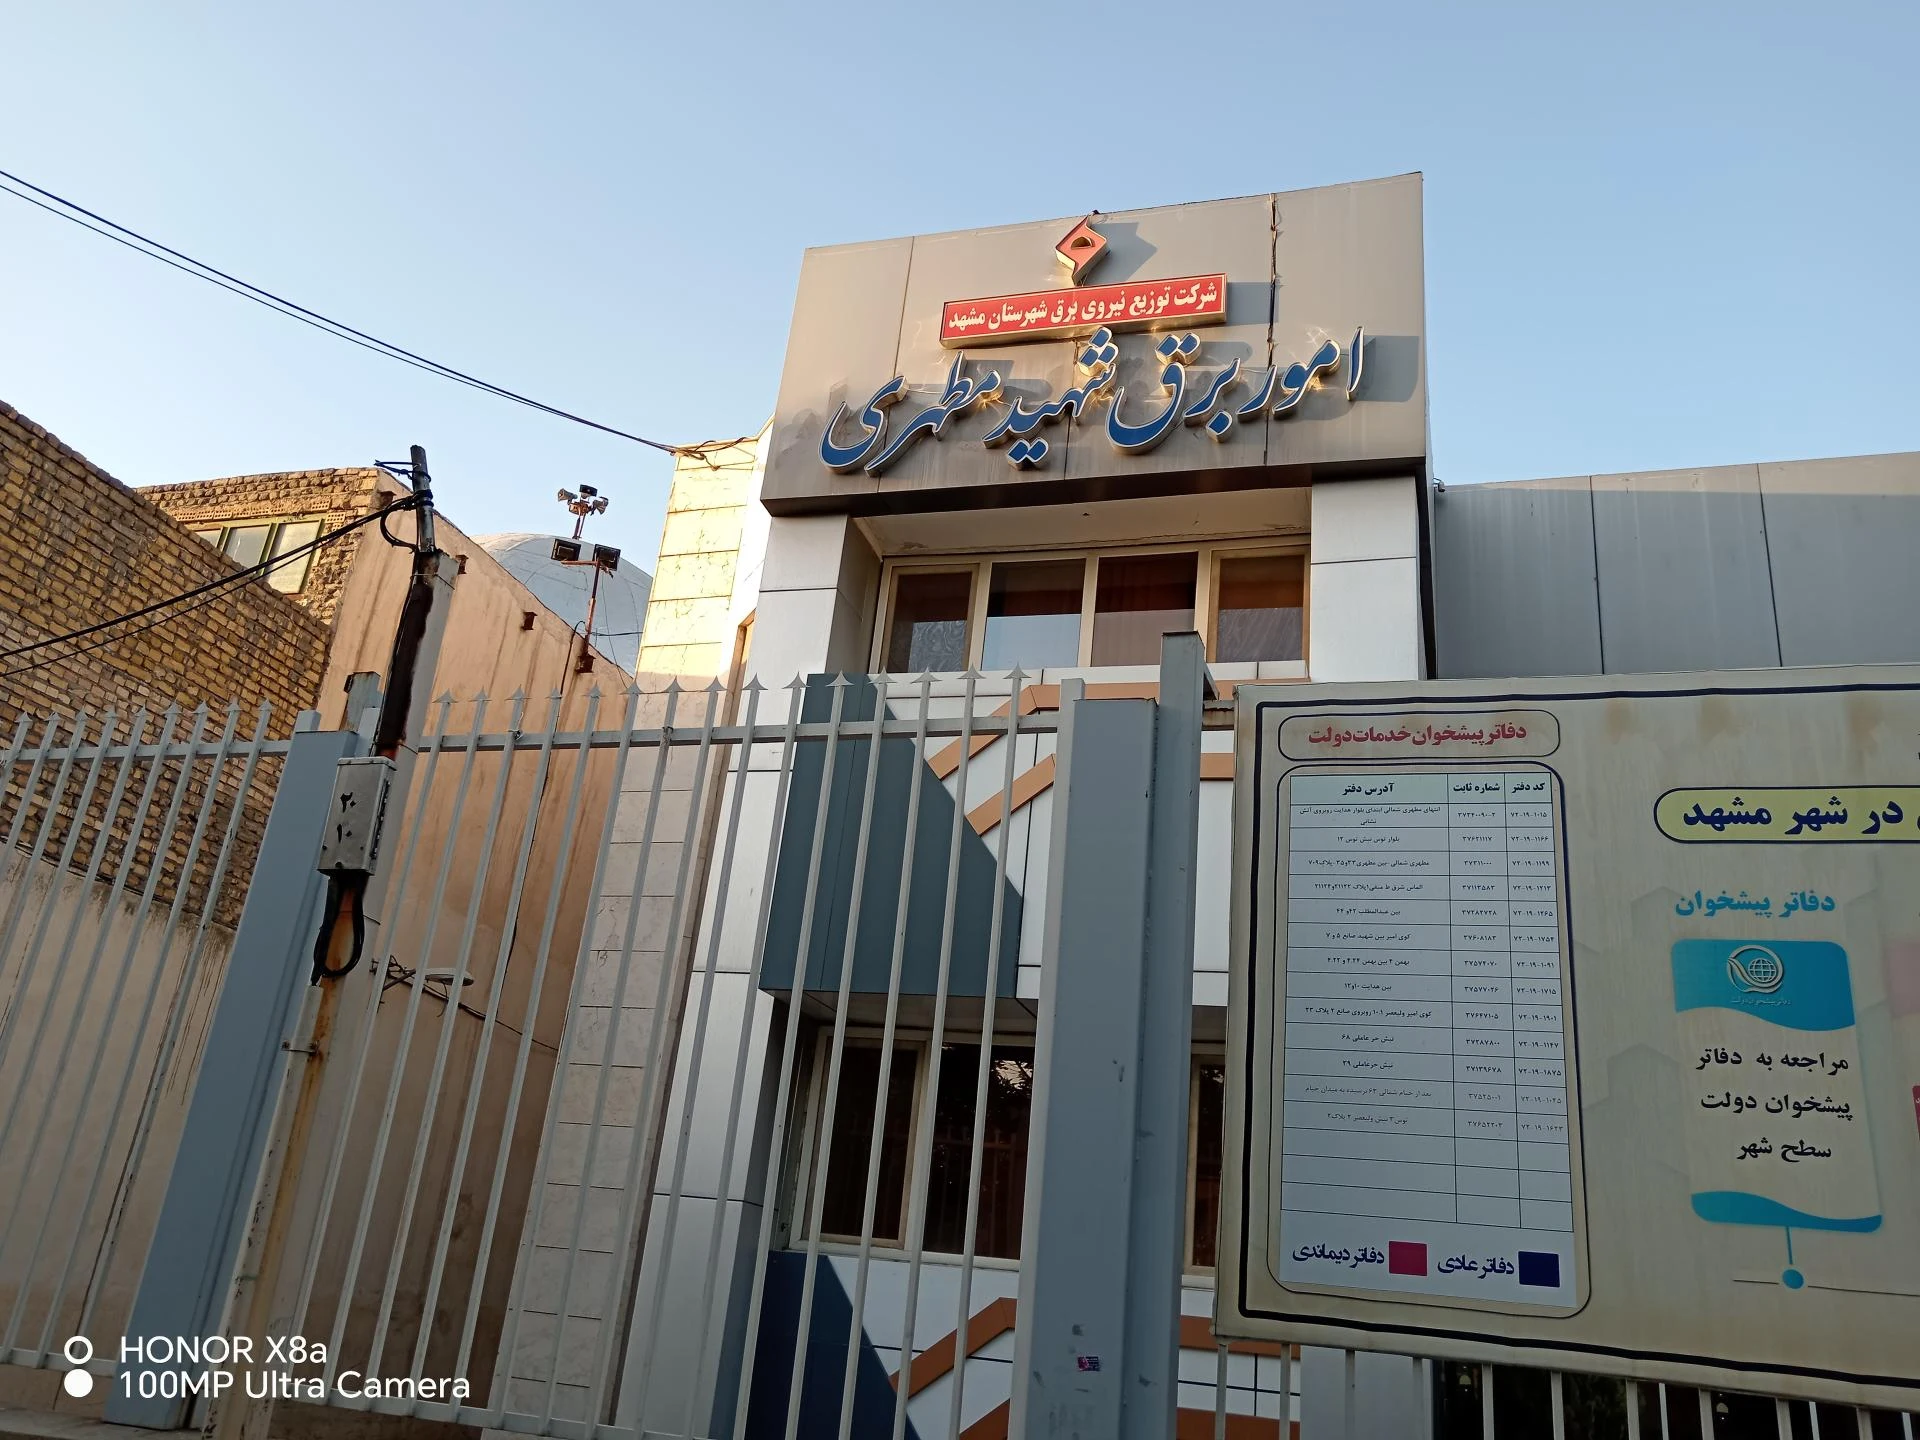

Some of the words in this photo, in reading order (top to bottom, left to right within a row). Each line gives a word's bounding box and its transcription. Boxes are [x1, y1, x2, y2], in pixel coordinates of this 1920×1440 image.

[1081, 291, 1126, 319] نیروی
[1130, 288, 1171, 315] توزیع
[1174, 282, 1217, 309] شرکت
[949, 308, 986, 331] مشهد
[988, 299, 1048, 330] شهرستان
[1050, 298, 1077, 322] برق
[1237, 326, 1365, 421] امور
[982, 326, 1120, 469] شهید
[1104, 330, 1240, 456] برق
[818, 350, 1003, 477] مطهری
[1309, 727, 1353, 747] دولت
[1353, 726, 1411, 742] خدمات
[1412, 725, 1485, 746] پیشخوان
[1485, 722, 1527, 745] دفاتر
[1342, 783, 1362, 795] دفتر
[1365, 783, 1395, 795] آدرس
[1453, 782, 1473, 794] ثابت
[1475, 782, 1500, 793] شماره
[1512, 782, 1531, 793] دفتر
[1533, 782, 1545, 791] کد
[1683, 796, 1772, 832] مشهد
[1784, 796, 1848, 835] شهر
[1861, 801, 1903, 834] در
[1675, 889, 1773, 918] پیشخوان
[1779, 889, 1835, 917] دفاتر
[1696, 1047, 1743, 1070] دفاتر
[1756, 1053, 1772, 1071] به
[1780, 1052, 1849, 1076] مراجعه
[1701, 1092, 1757, 1113] دولت
[1765, 1094, 1853, 1121] پیشخوان
[1737, 1137, 1773, 1159] شهر
[1781, 1139, 1831, 1163] سطح
[1292, 1243, 1351, 1264] دیماندی
[1349, 1246, 1385, 1268] دفاتر
[1437, 1255, 1478, 1274] عادی
[1478, 1257, 1514, 1279] دفاتر
